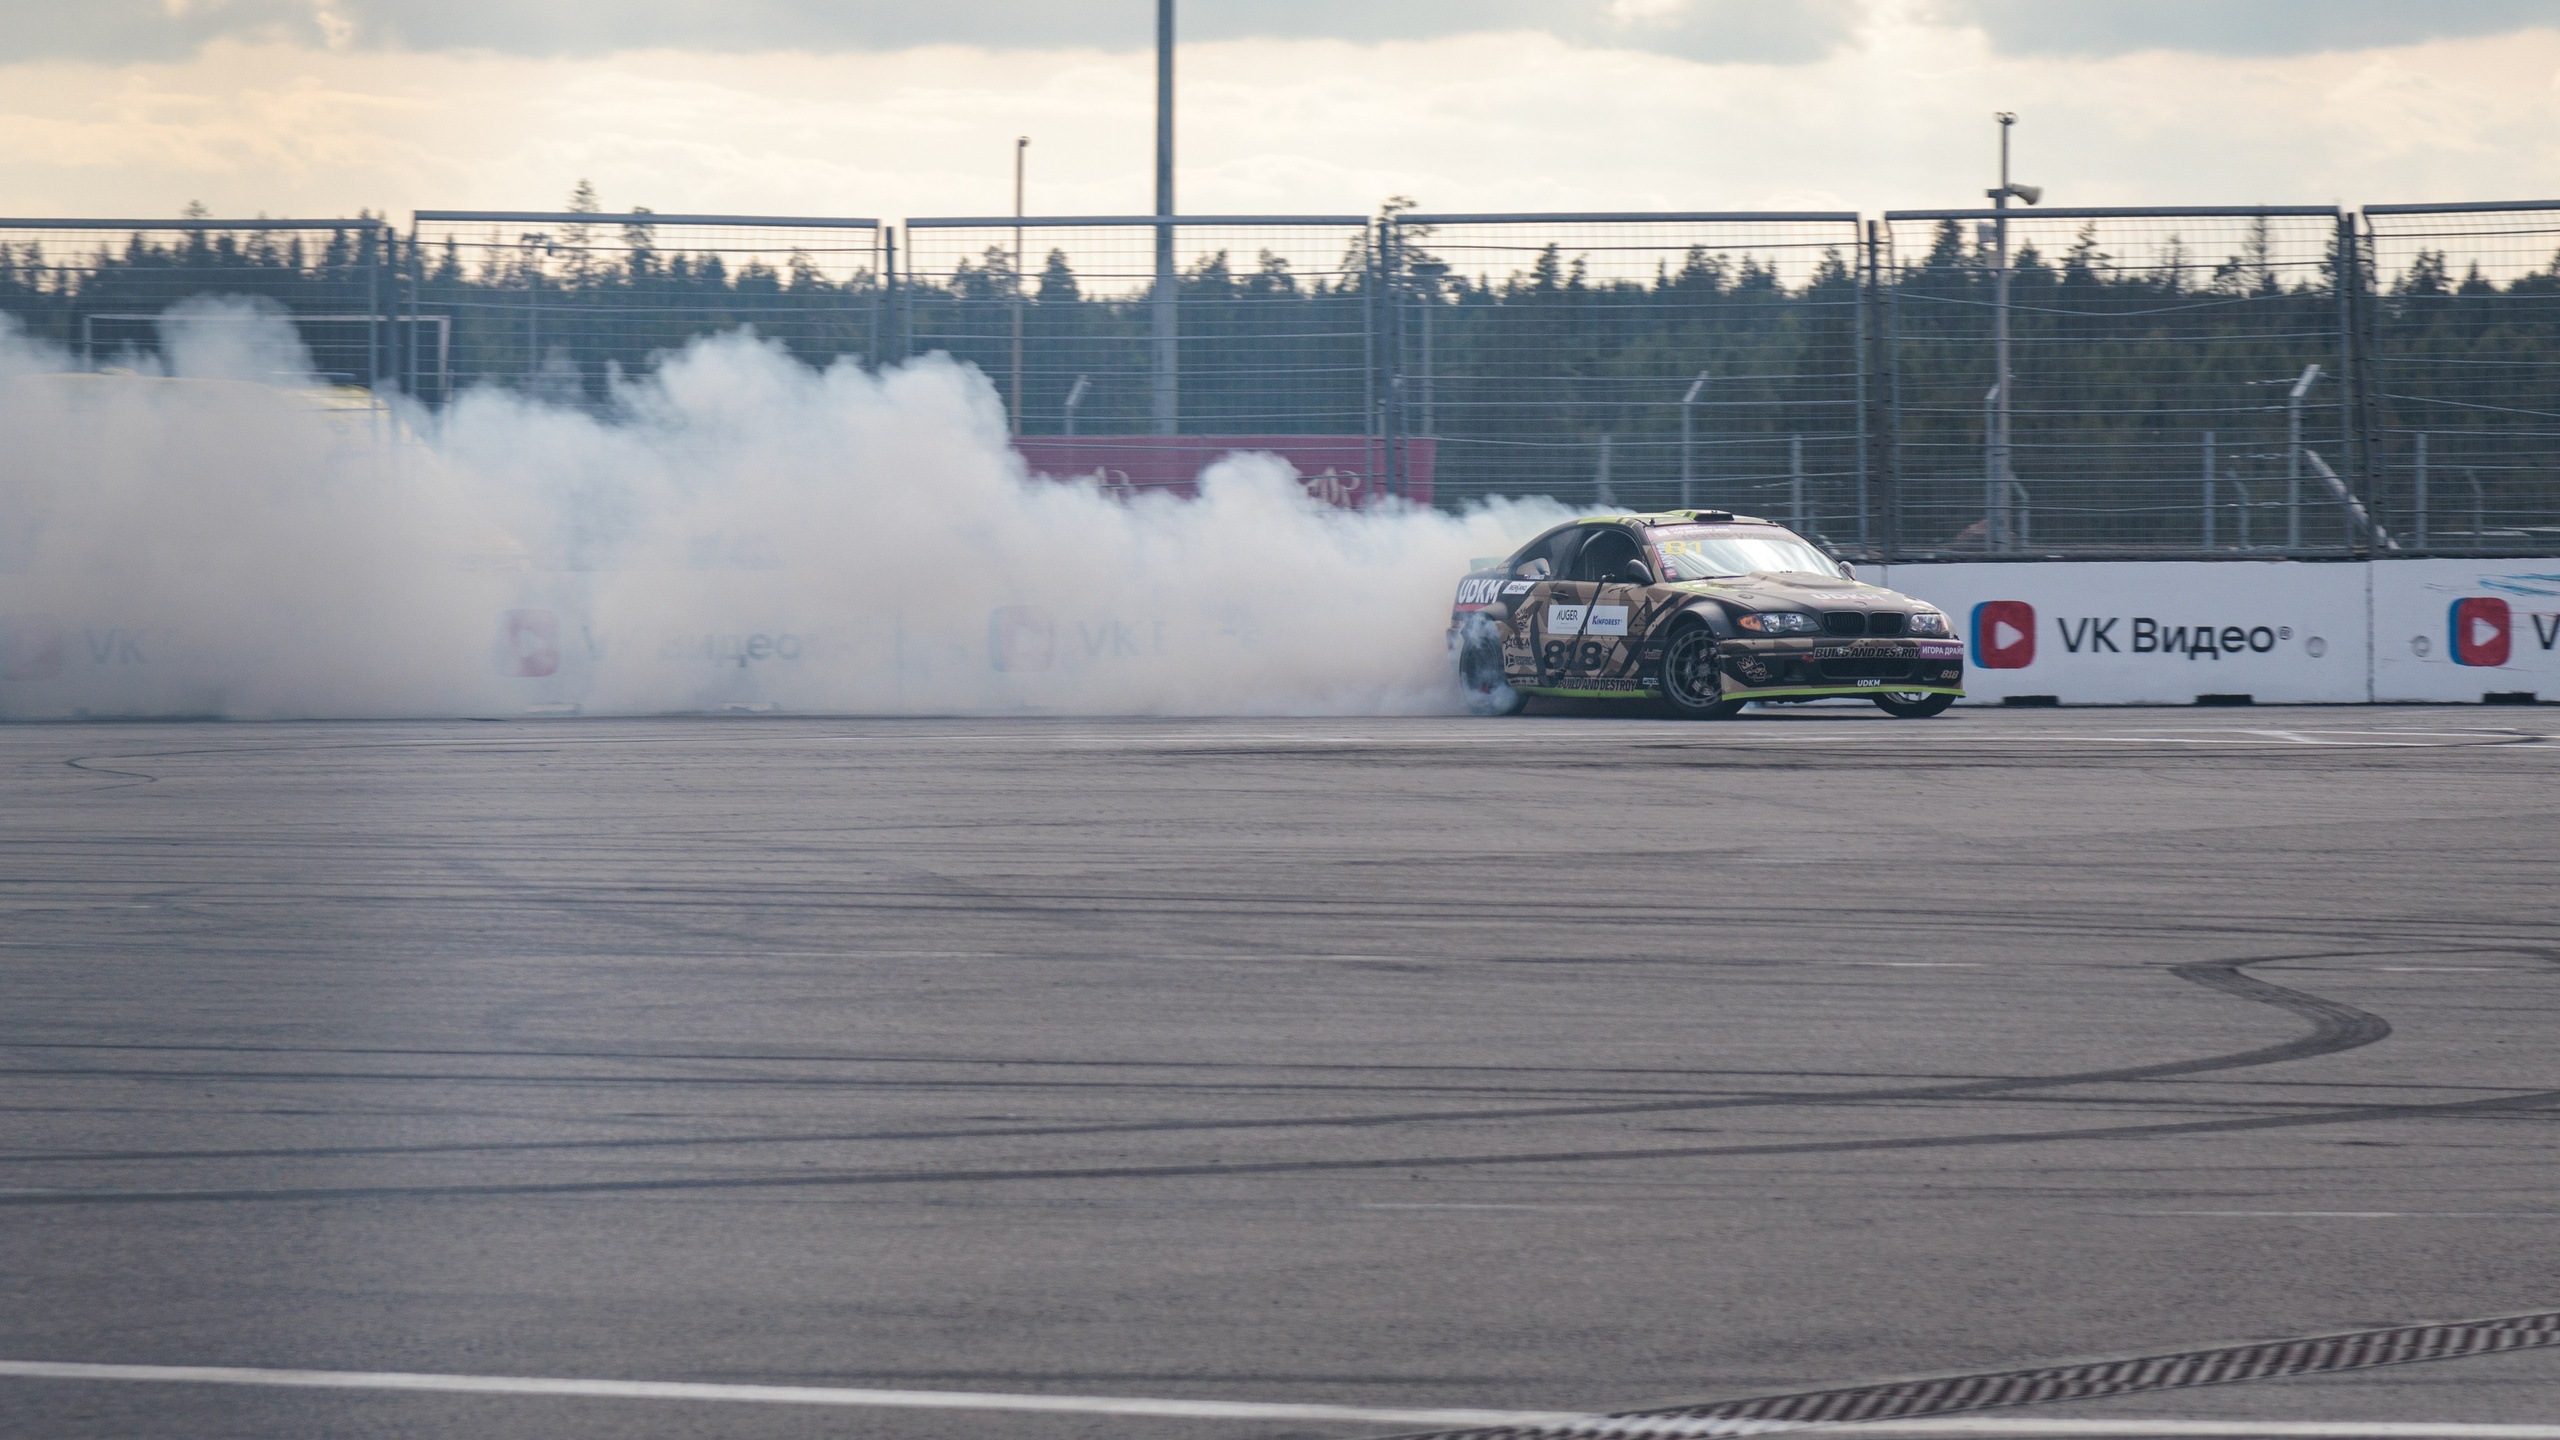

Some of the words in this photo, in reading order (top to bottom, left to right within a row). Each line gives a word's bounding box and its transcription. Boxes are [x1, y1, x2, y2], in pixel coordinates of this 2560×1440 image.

[1458, 580, 1504, 604] UDKM
[1556, 609, 1578, 621] AUGER
[1592, 615, 1621, 626] KINFOREST
[2056, 617, 2121, 653] VK
[1850, 646, 1875, 658] AND
[1922, 646, 1944, 654] ИГОРА
[1941, 670, 1959, 679] 818
[1580, 677, 1600, 691] AND
[1600, 678, 1638, 692] DESTROY
